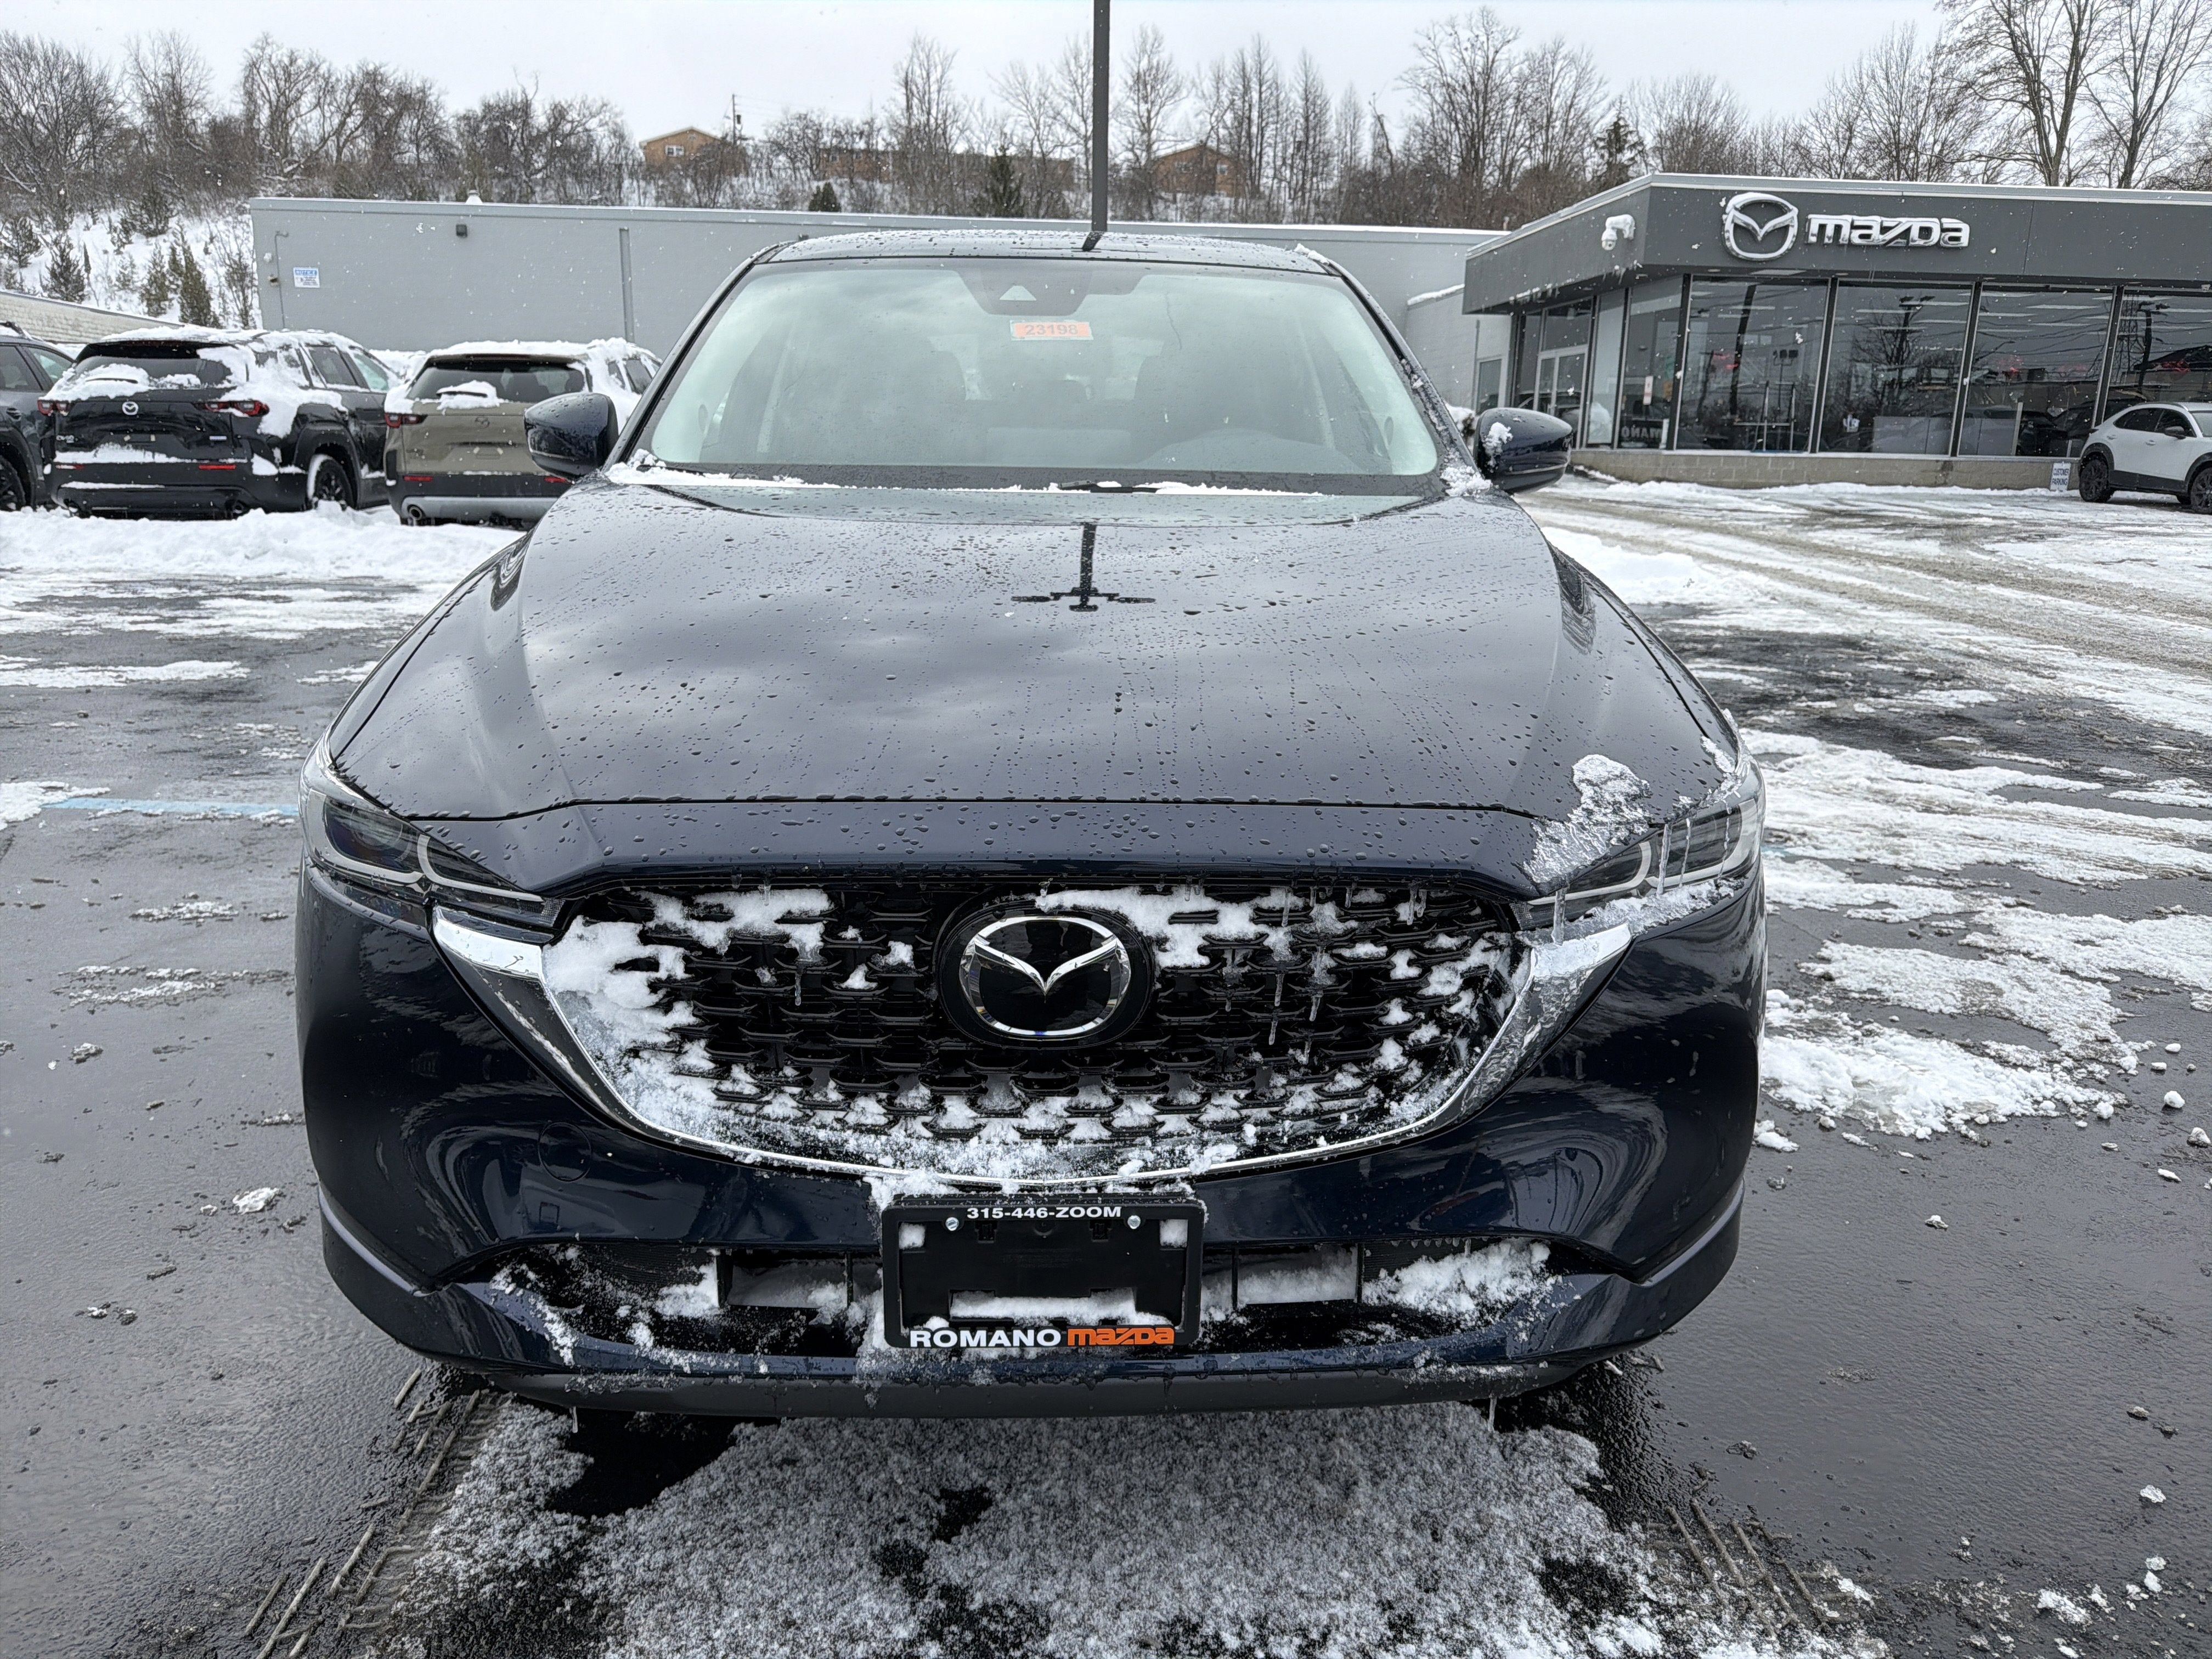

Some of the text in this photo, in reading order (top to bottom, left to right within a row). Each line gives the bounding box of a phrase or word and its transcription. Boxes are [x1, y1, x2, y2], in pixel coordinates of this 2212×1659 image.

[1025, 324, 1078, 335] 23198
[967, 1206, 1122, 1219] 315-446-ZOOM
[910, 1329, 1062, 1347] ROMANO
